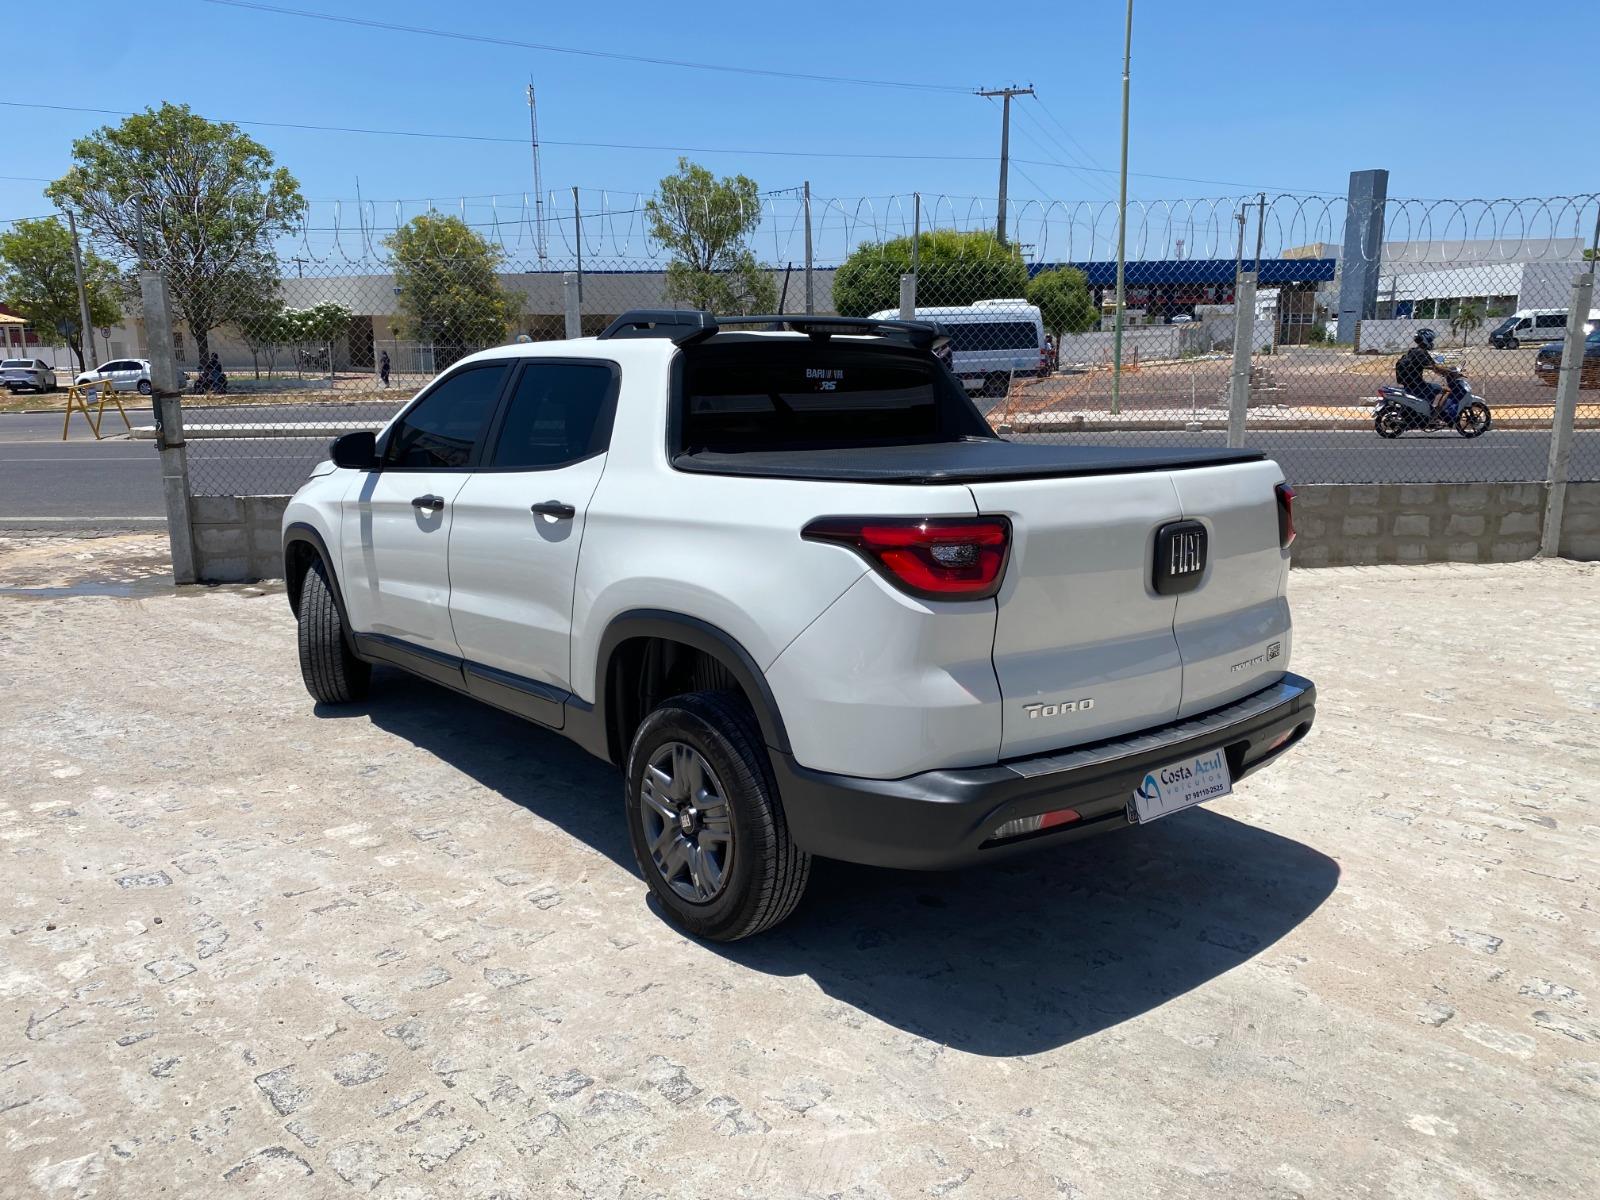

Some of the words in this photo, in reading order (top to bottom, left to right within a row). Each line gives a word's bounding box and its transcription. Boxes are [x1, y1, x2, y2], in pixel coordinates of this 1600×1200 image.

[1170, 531, 1203, 575] FIAT
[1022, 698, 1095, 719] TORO
[1160, 767, 1193, 785] Costa
[1195, 752, 1222, 776] Azul
